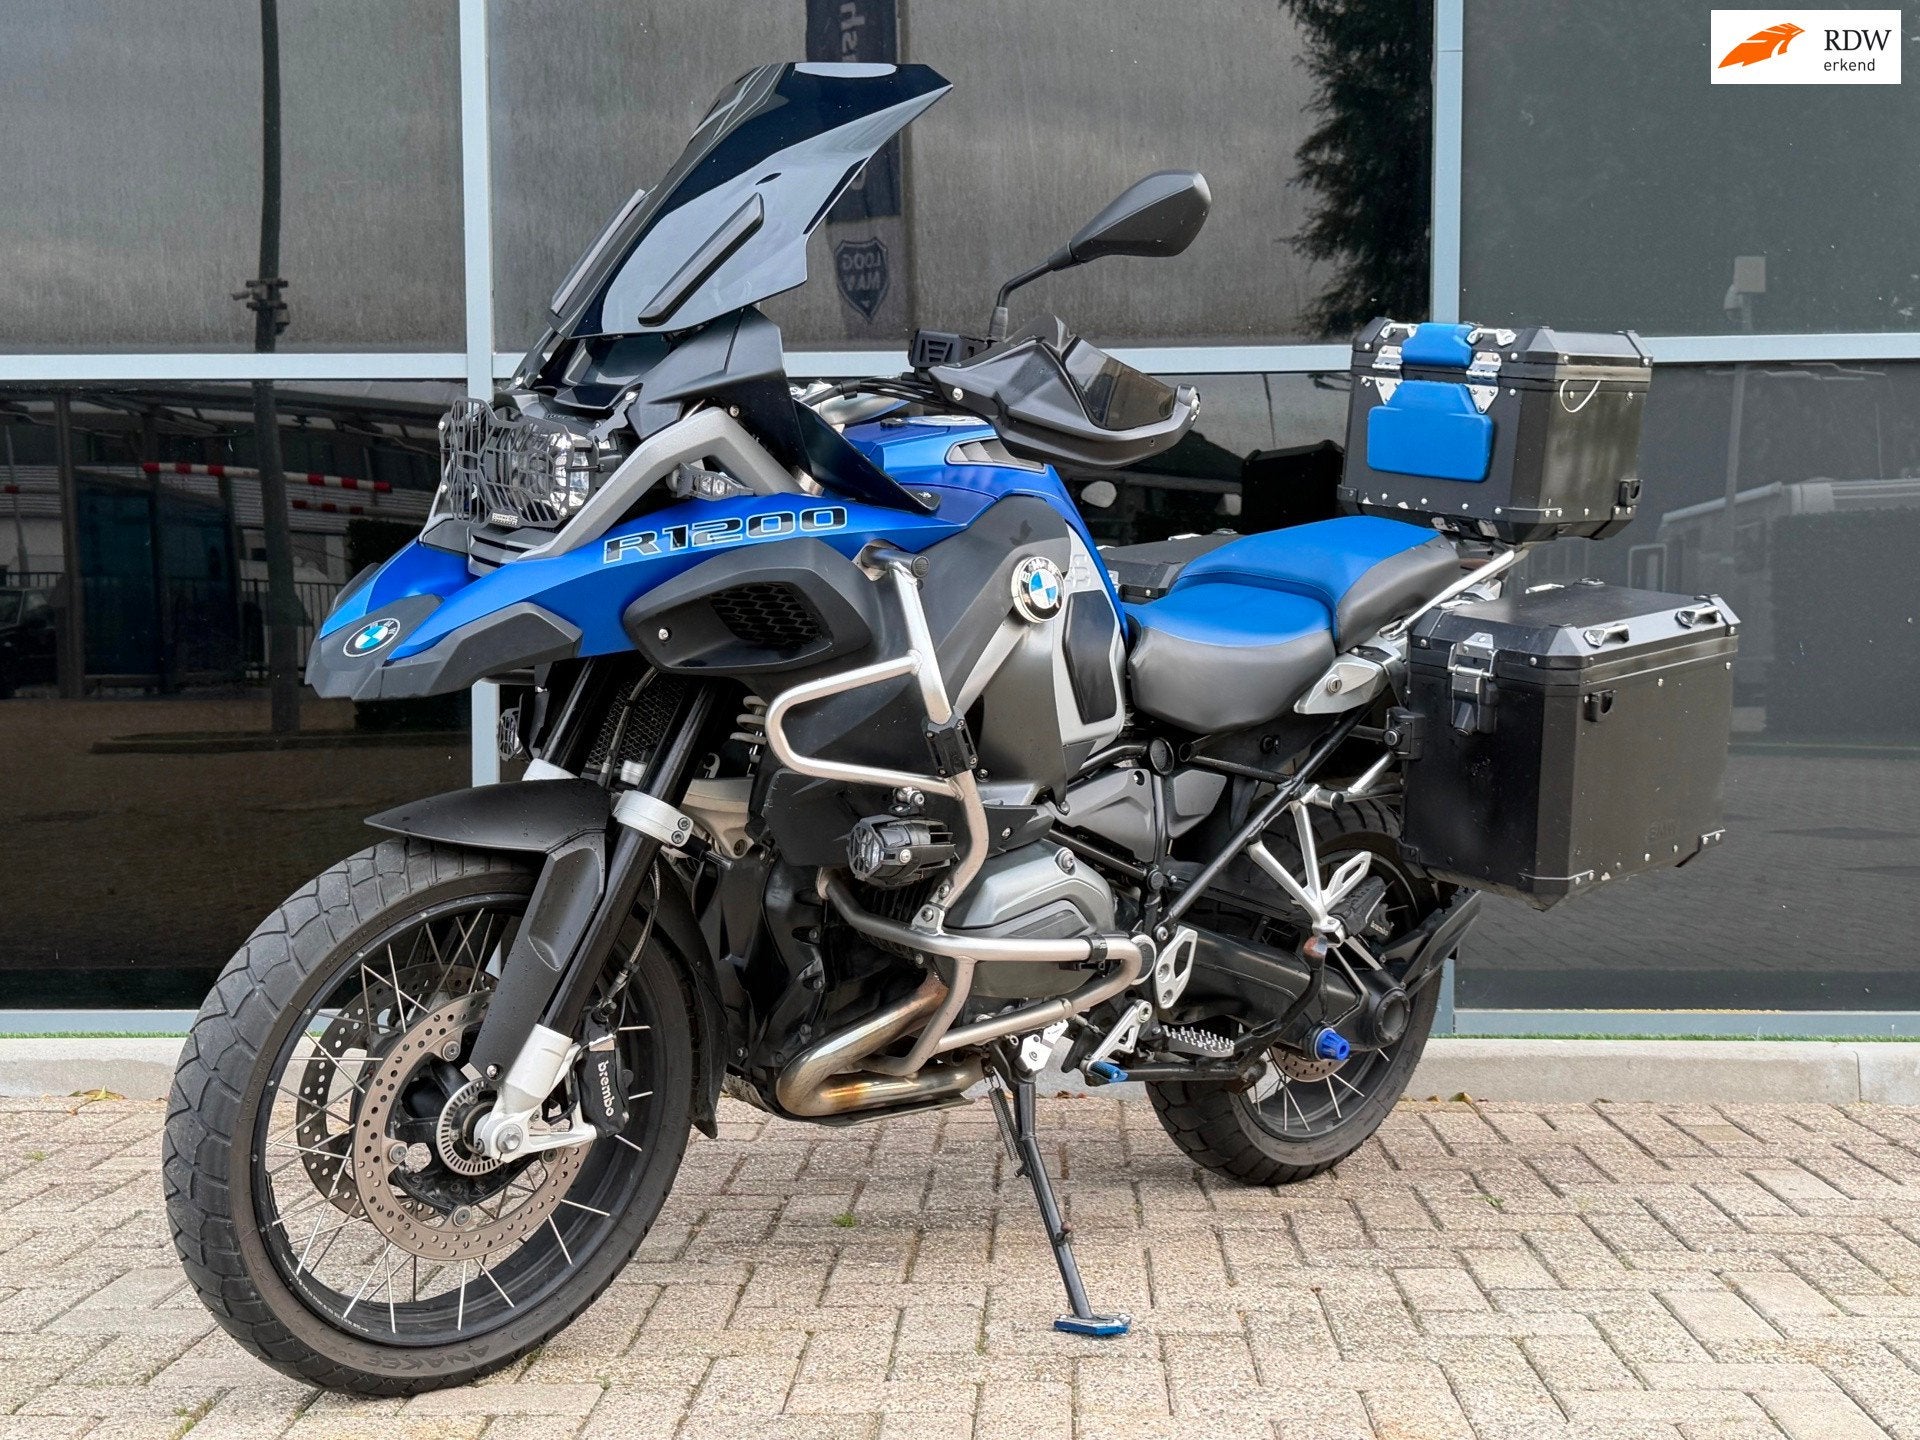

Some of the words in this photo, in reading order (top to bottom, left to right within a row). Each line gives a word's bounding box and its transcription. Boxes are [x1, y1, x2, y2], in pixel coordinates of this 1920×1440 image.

[603, 506, 847, 564] R1200
[597, 1060, 615, 1117] brembo
[363, 1345, 490, 1371] ANAKEE
